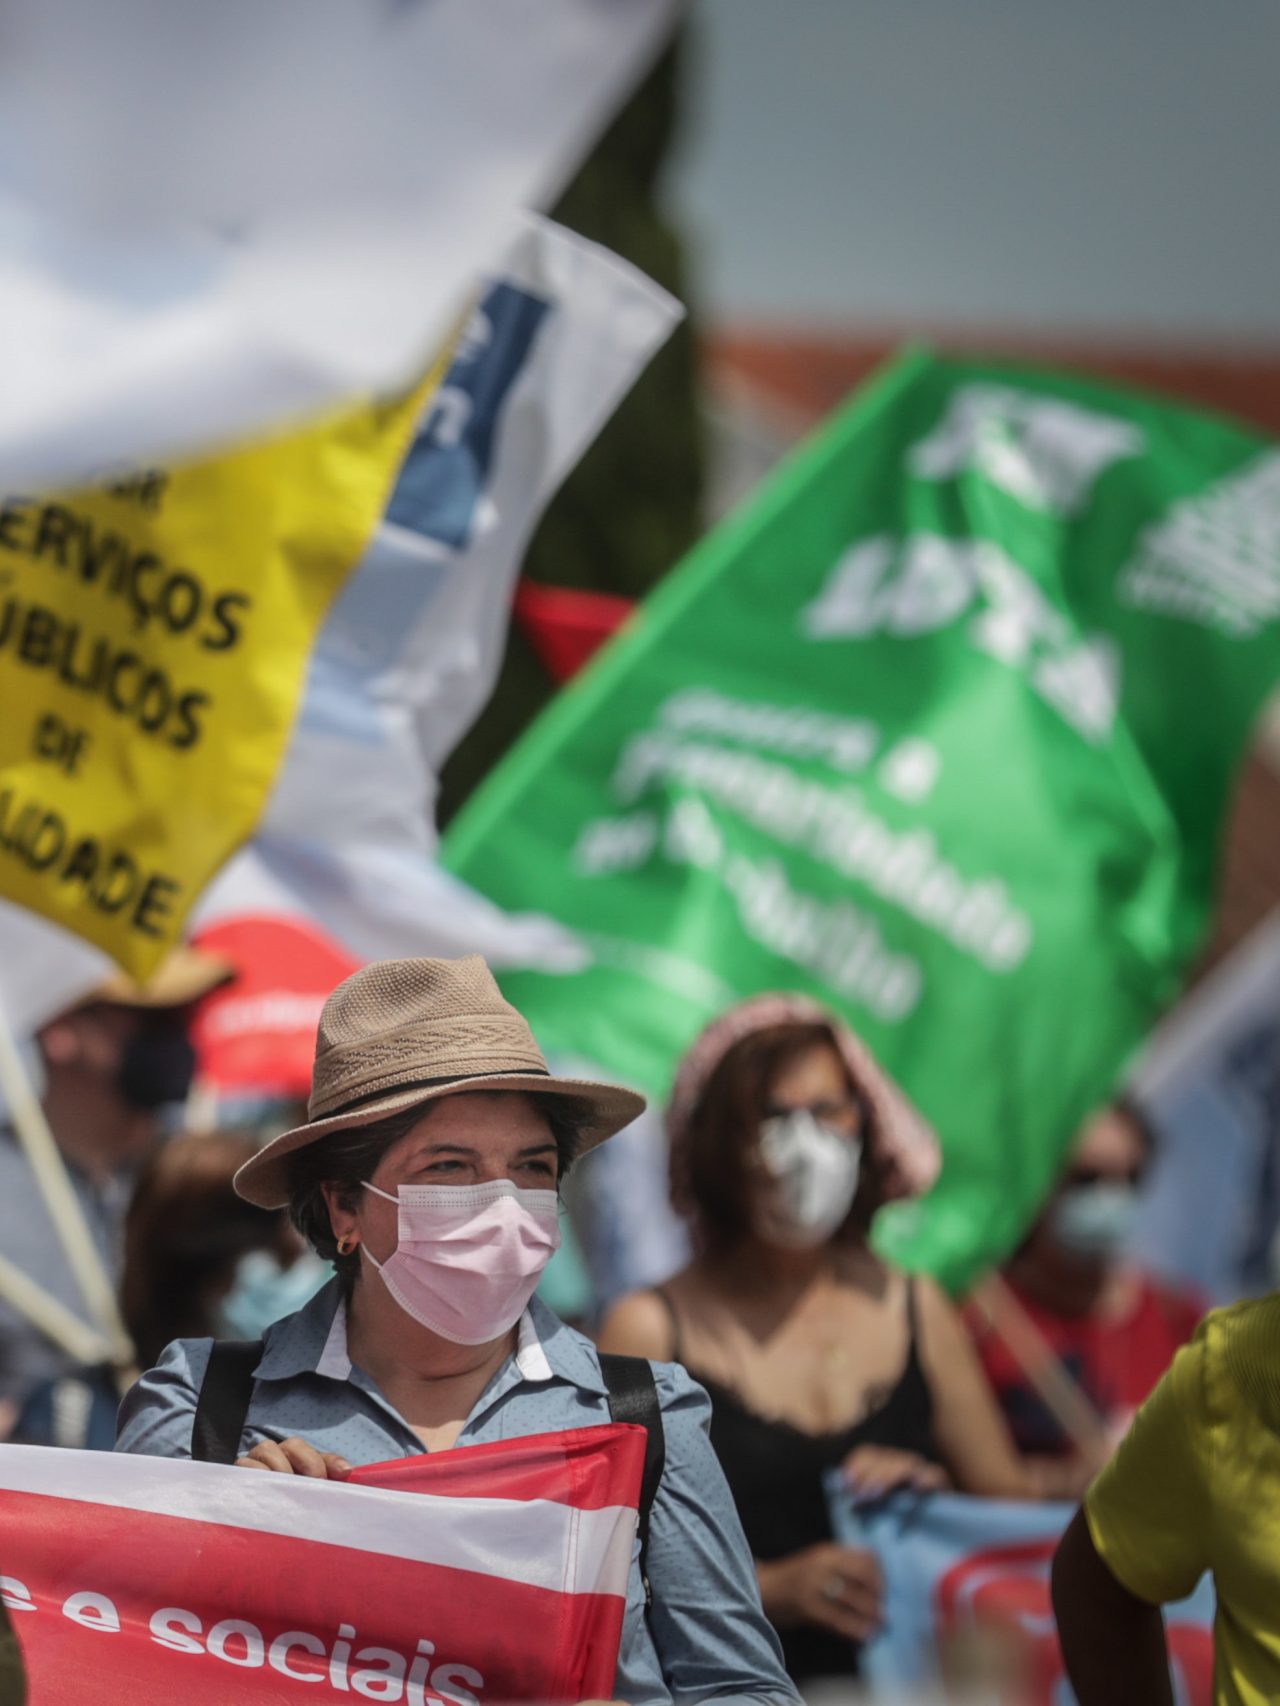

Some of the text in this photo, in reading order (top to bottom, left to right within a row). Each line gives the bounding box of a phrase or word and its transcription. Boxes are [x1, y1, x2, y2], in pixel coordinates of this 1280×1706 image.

[33, 712, 91, 778] DE
[62, 1590, 121, 1632] e
[147, 1607, 484, 1706] sociais
